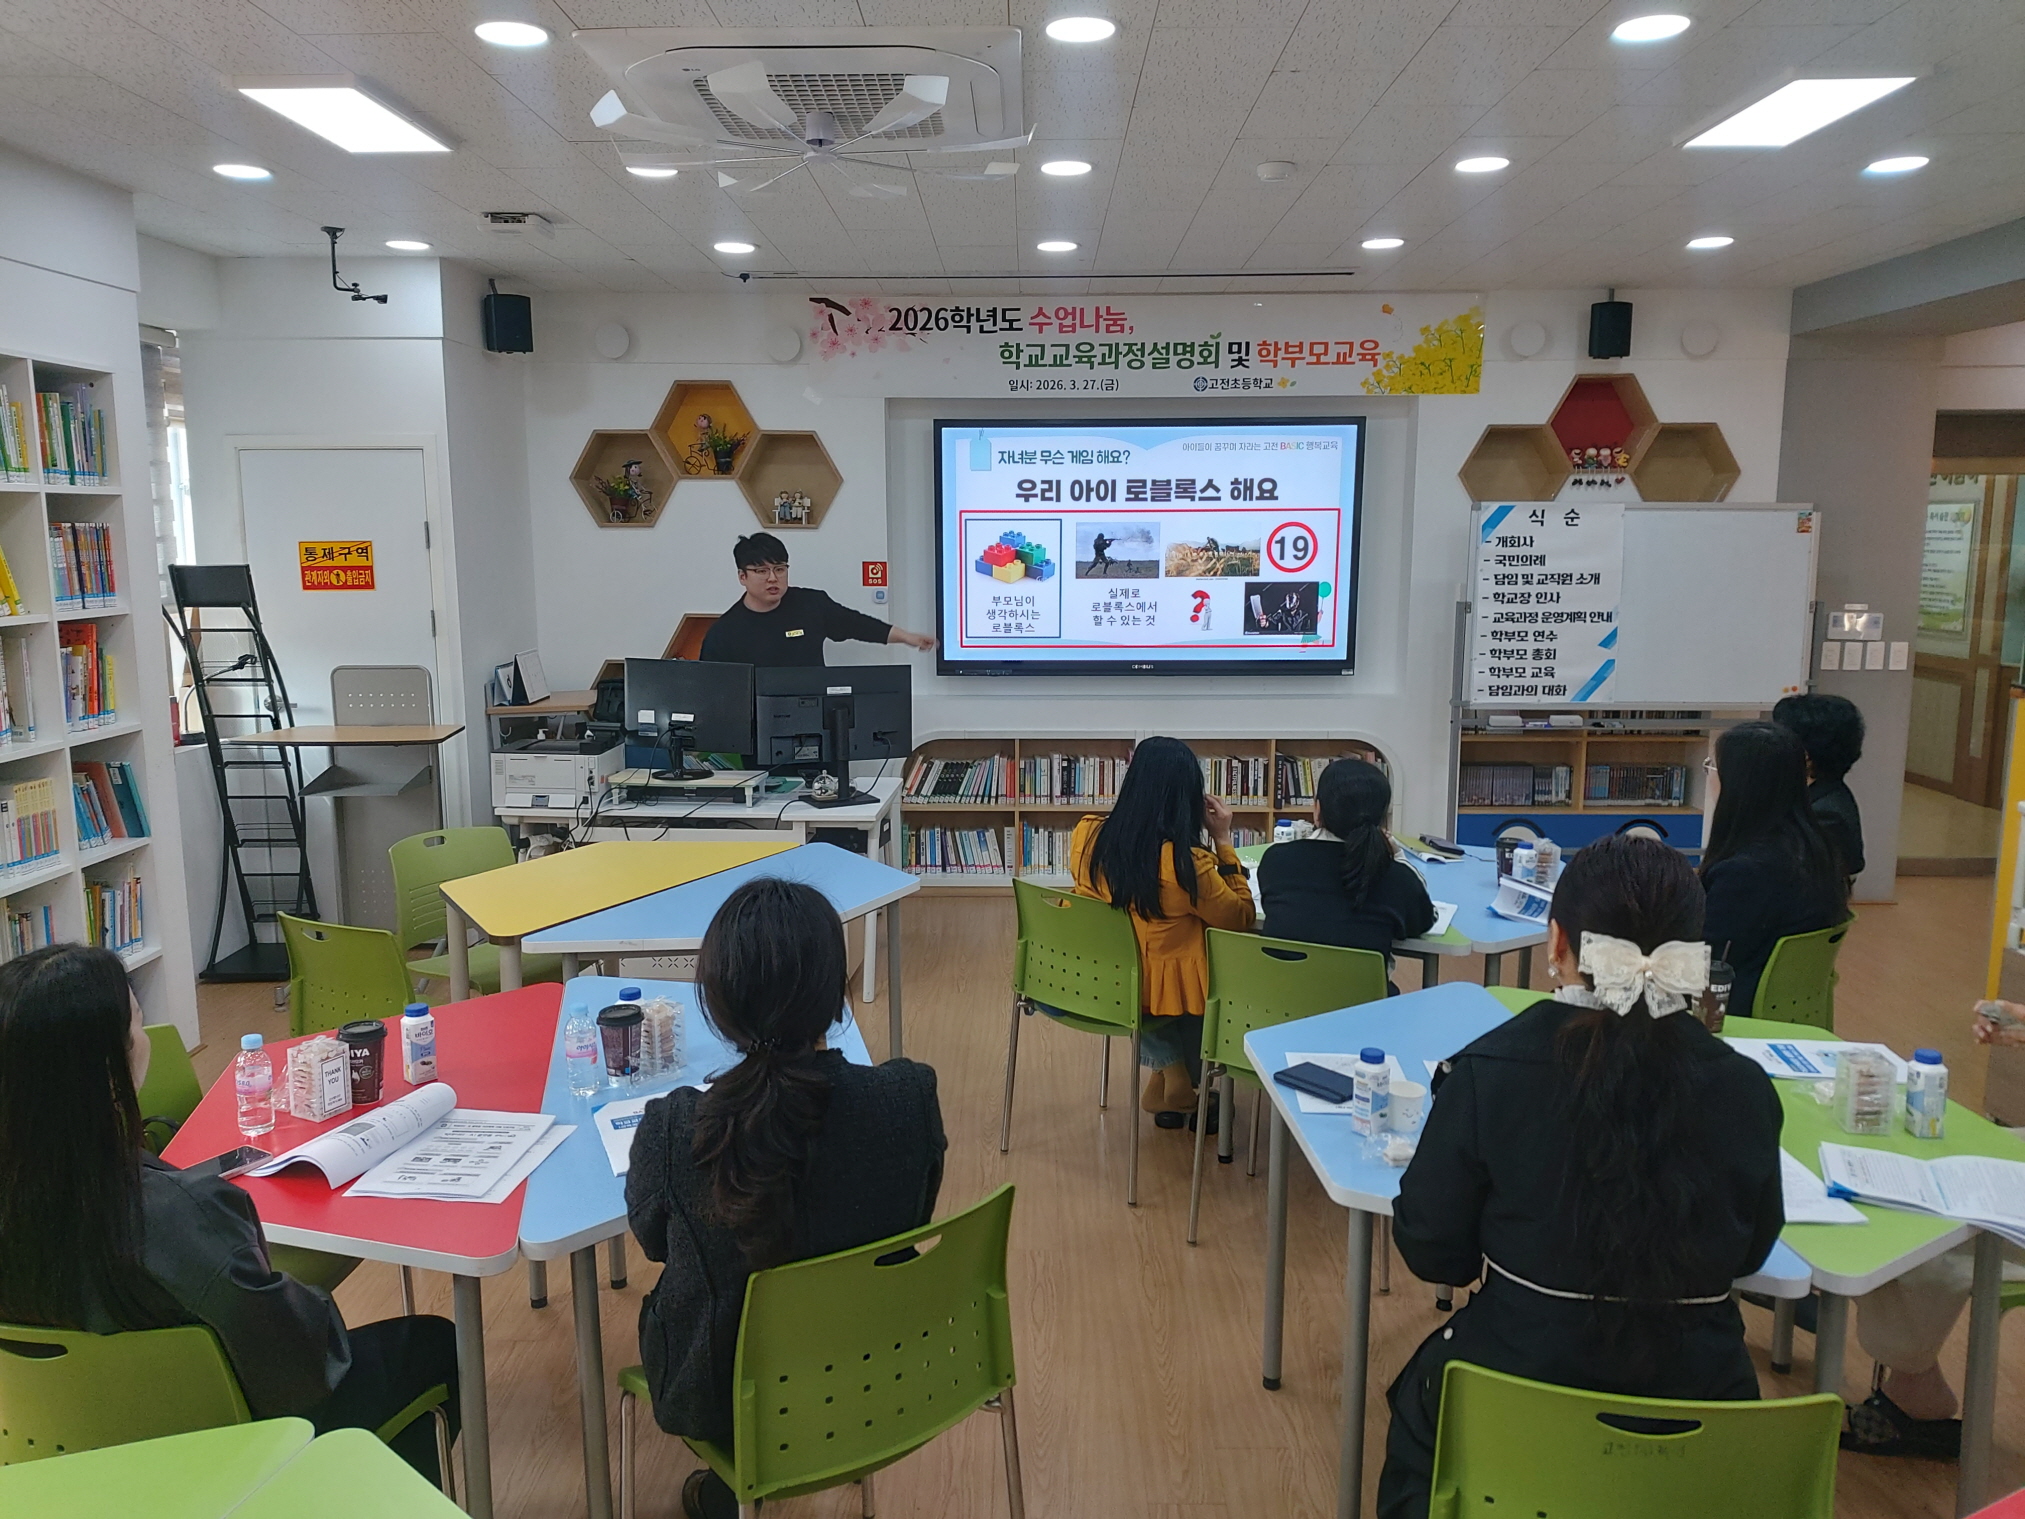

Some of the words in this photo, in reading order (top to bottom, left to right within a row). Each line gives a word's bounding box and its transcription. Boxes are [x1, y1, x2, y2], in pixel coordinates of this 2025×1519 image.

[888, 305, 1024, 335] 2026학년도
[1028, 305, 1134, 335] 수업나눔,
[999, 340, 1221, 370] 학교교육과정설명회
[1227, 341, 1251, 369] 및
[1257, 339, 1380, 369] 학부모교육
[1008, 379, 1033, 392] 일시:
[1035, 379, 1067, 391] 2026.
[1070, 379, 1080, 391] 3.
[1082, 378, 1120, 392] 27.(금)
[1208, 377, 1274, 390] 고전초등학교
[1182, 443, 1212, 451] 아이들이
[1214, 443, 1237, 451] 꿈꾸며
[1238, 442, 1261, 451] 자라는
[1263, 442, 1278, 451] 고전
[1280, 442, 1304, 450] BASIC
[1306, 441, 1338, 450] 행복교육
[997, 450, 1038, 465] 자녀분
[1039, 450, 1066, 465] 무슨
[1067, 449, 1095, 465] 게임
[1096, 449, 1131, 465] 해요?
[1015, 479, 1061, 502] 우리
[1070, 479, 1117, 502] 아이
[1125, 478, 1222, 502] 로블록스
[1230, 478, 1279, 501] 해요
[1528, 508, 1546, 527] 식
[1563, 508, 1581, 527] 순
[1274, 535, 1310, 561] 19
[1495, 535, 1535, 548] 개회사
[303, 546, 369, 562] 통제구역
[1494, 554, 1547, 567] 국민의례
[304, 570, 331, 586] 관계자외
[346, 569, 372, 586] 출입금지
[1493, 572, 1519, 586] 담임
[1521, 572, 1534, 586] 및
[1536, 572, 1573, 586] 교직원
[1575, 572, 1601, 586] 소개
[1108, 587, 1141, 600] 실제로
[1492, 591, 1532, 605] 학교장
[1535, 591, 1561, 605] 인사
[991, 594, 1035, 607] 부모님이
[1090, 601, 1158, 613] 로블록스에서
[985, 608, 1041, 621] 생각하시는
[1092, 614, 1109, 627] 할
[1109, 614, 1118, 627] 수
[1119, 614, 1142, 627] 있는
[1145, 614, 1156, 627] 것
[1492, 611, 1539, 624] 교육과정
[1541, 611, 1587, 624] 운영계획
[1589, 611, 1613, 624] 안내
[991, 622, 1036, 634] 로블록스
[1490, 630, 1529, 642] 학부모
[1532, 630, 1558, 642] 연수
[1489, 648, 1529, 661] 학부모
[1531, 648, 1557, 661] 총회
[1488, 666, 1528, 679] 학부모
[1530, 666, 1556, 679] 교육
[1487, 684, 1538, 697] 담임과의
[1541, 684, 1568, 697] 대화
[350, 1048, 370, 1058] IYA
[324, 1065, 342, 1078] THANK
[327, 1075, 340, 1085] YOU
